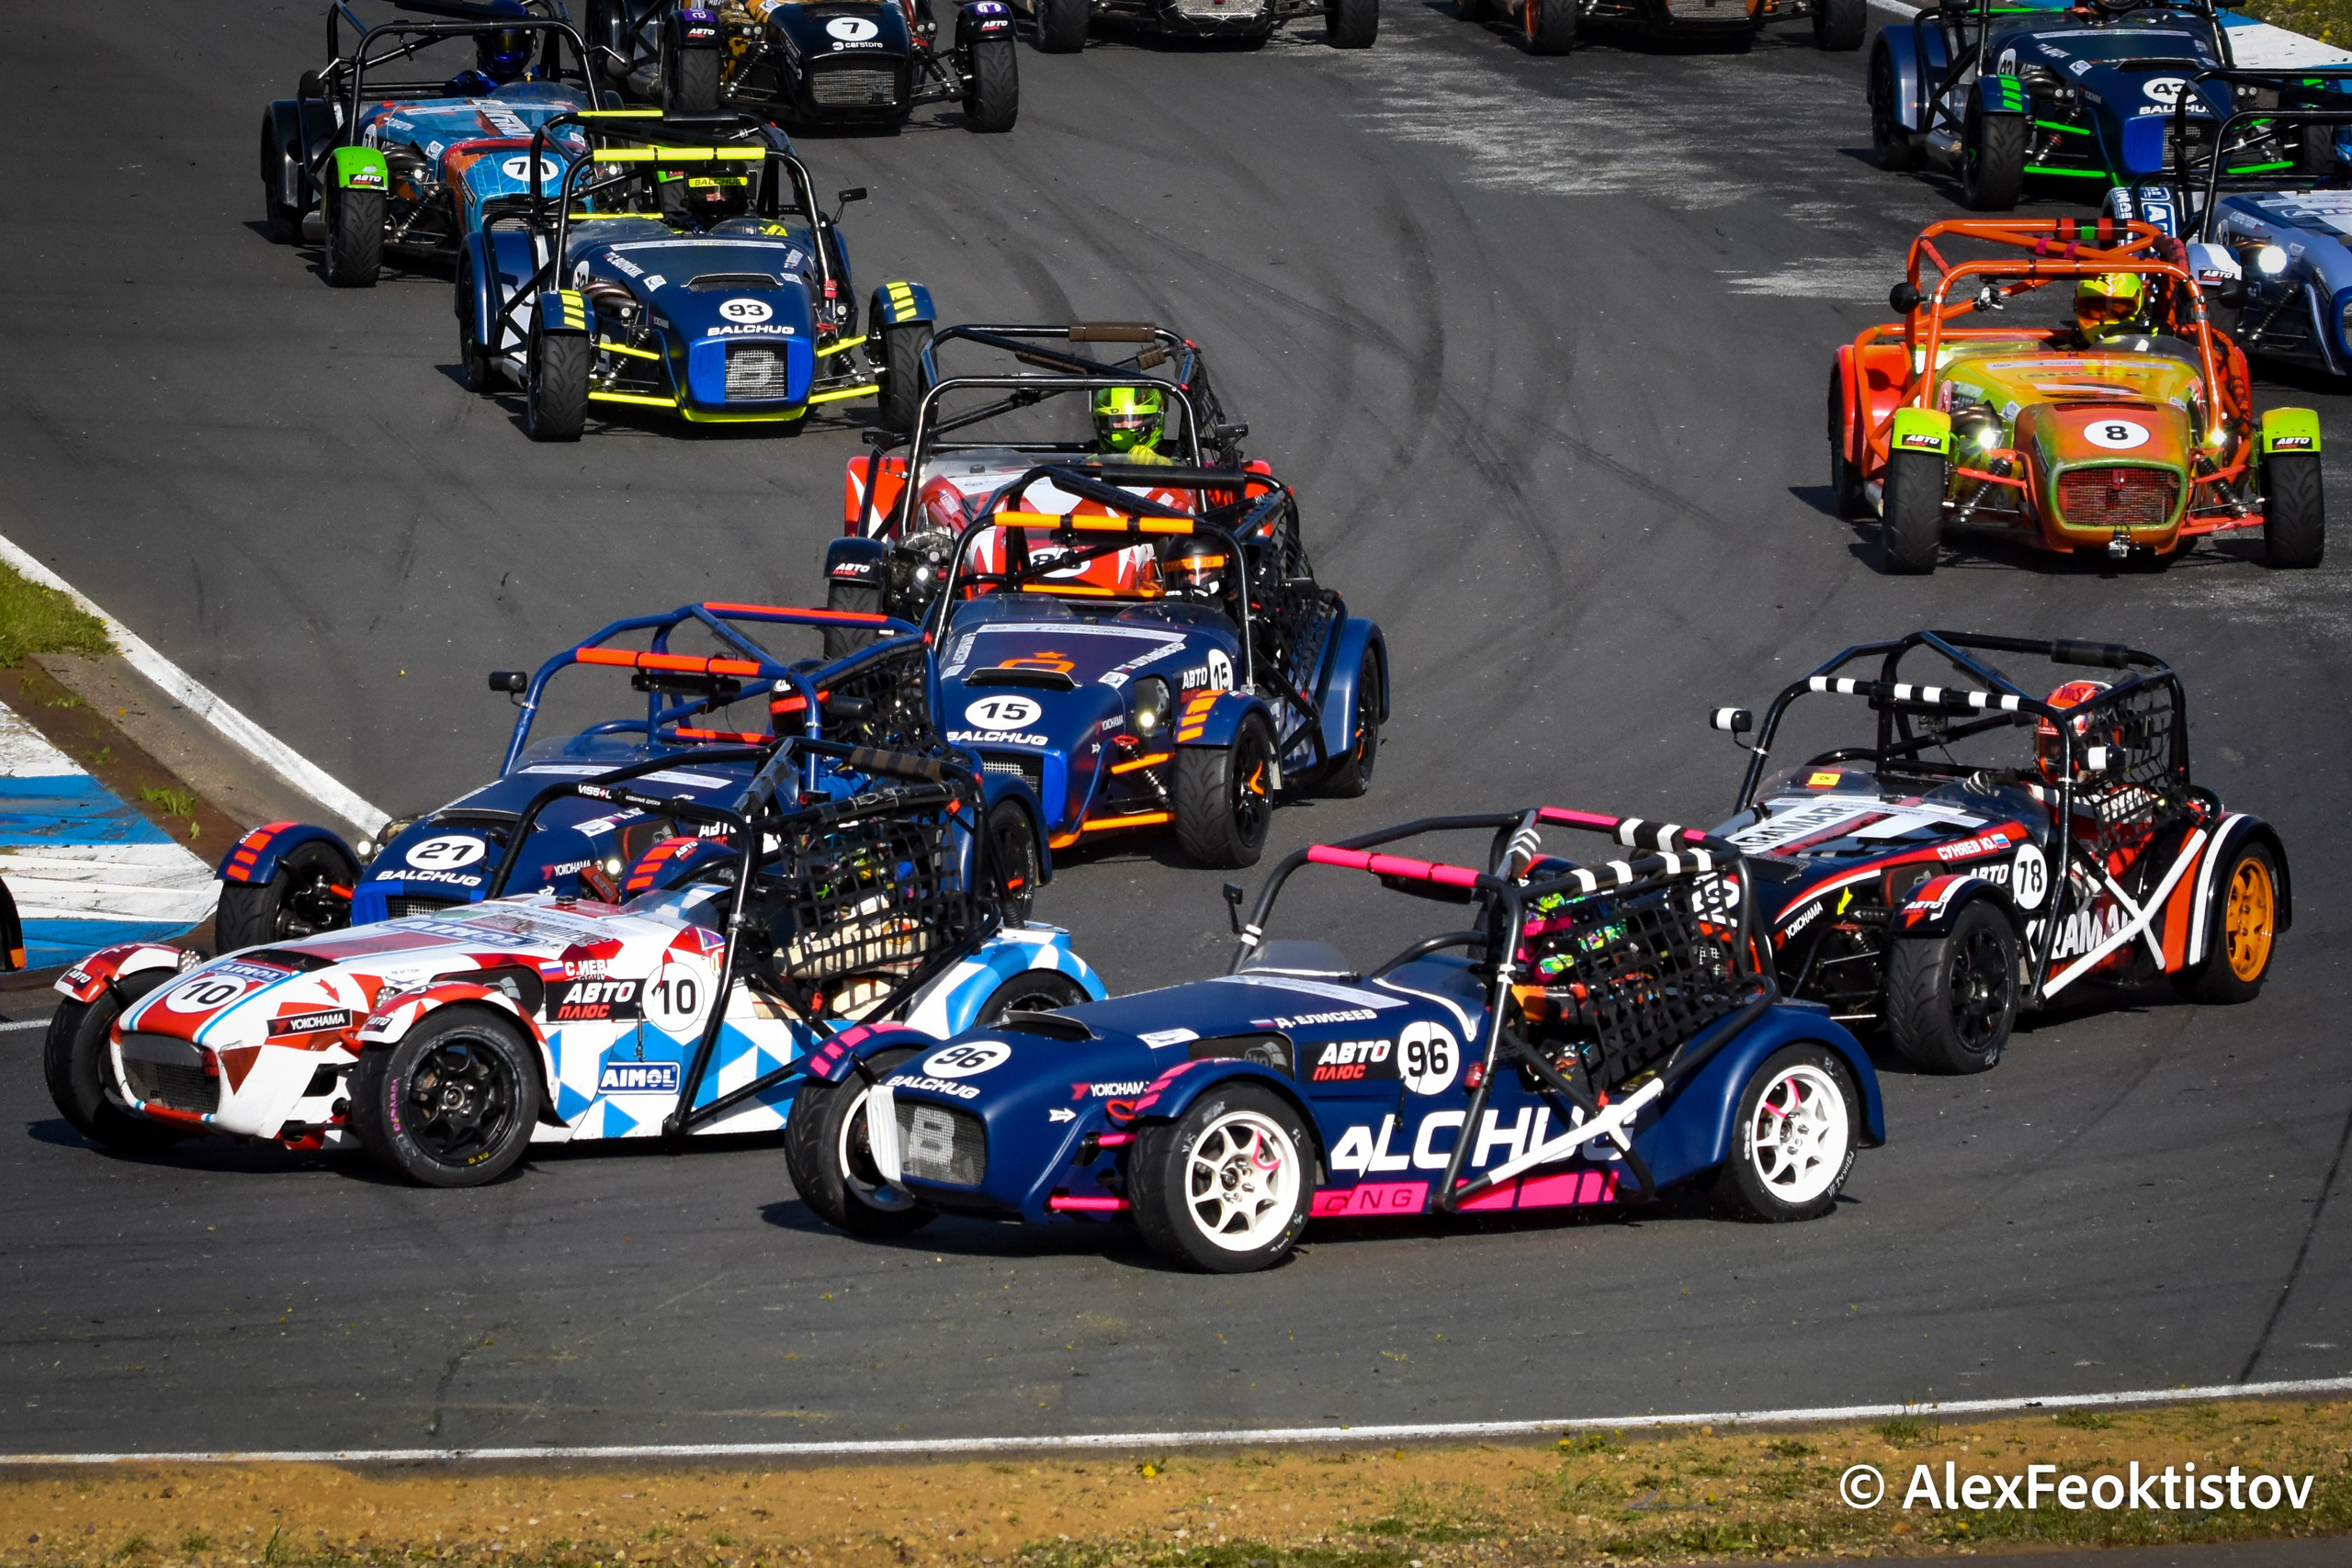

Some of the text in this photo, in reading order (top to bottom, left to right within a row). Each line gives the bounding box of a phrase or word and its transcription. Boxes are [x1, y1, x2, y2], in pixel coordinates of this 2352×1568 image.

[849, 21, 865, 34] 7
[845, 41, 884, 50] carstore
[354, 175, 382, 183] АВТО
[2202, 270, 2234, 279] АВТО
[728, 304, 764, 317] 93
[707, 325, 795, 337] BALCHUG
[1905, 434, 1940, 446] АВТО
[2104, 424, 2129, 441] 8
[2276, 436, 2311, 445] АВТО
[835, 562, 871, 573] АВТО
[1182, 666, 1208, 690] АВТО
[1214, 661, 1229, 689] 15
[979, 702, 1030, 719] 15
[946, 731, 1048, 746] BALCHUG
[415, 842, 475, 862] 21
[674, 840, 698, 859] АВТО
[1937, 837, 1997, 861] СУНЯЕВ Ю.
[553, 859, 592, 877] YOKOHAMA
[375, 869, 482, 886] BALCHUG
[2018, 860, 2042, 896] 78
[1905, 901, 1942, 910] АВТО
[1785, 900, 1824, 940] YOKOHAMA
[69, 968, 93, 985] АВТО
[217, 964, 278, 983] AIMOL
[181, 980, 238, 1005] 10
[563, 981, 637, 1004] АВТО
[650, 978, 696, 1015] 10
[557, 1004, 611, 1019] ПЛЮС
[290, 1012, 345, 1030] YOKOHAMA
[368, 1016, 392, 1027] АВТО
[933, 1046, 999, 1068] 96
[1318, 1040, 1391, 1066] АВТО
[1407, 1038, 1449, 1077] 96
[601, 1068, 676, 1088] AIMOL
[1313, 1065, 1366, 1081] ПЛЮС
[885, 1076, 980, 1100] BALCHUG
[1091, 1081, 1150, 1097] YOKOHAM
